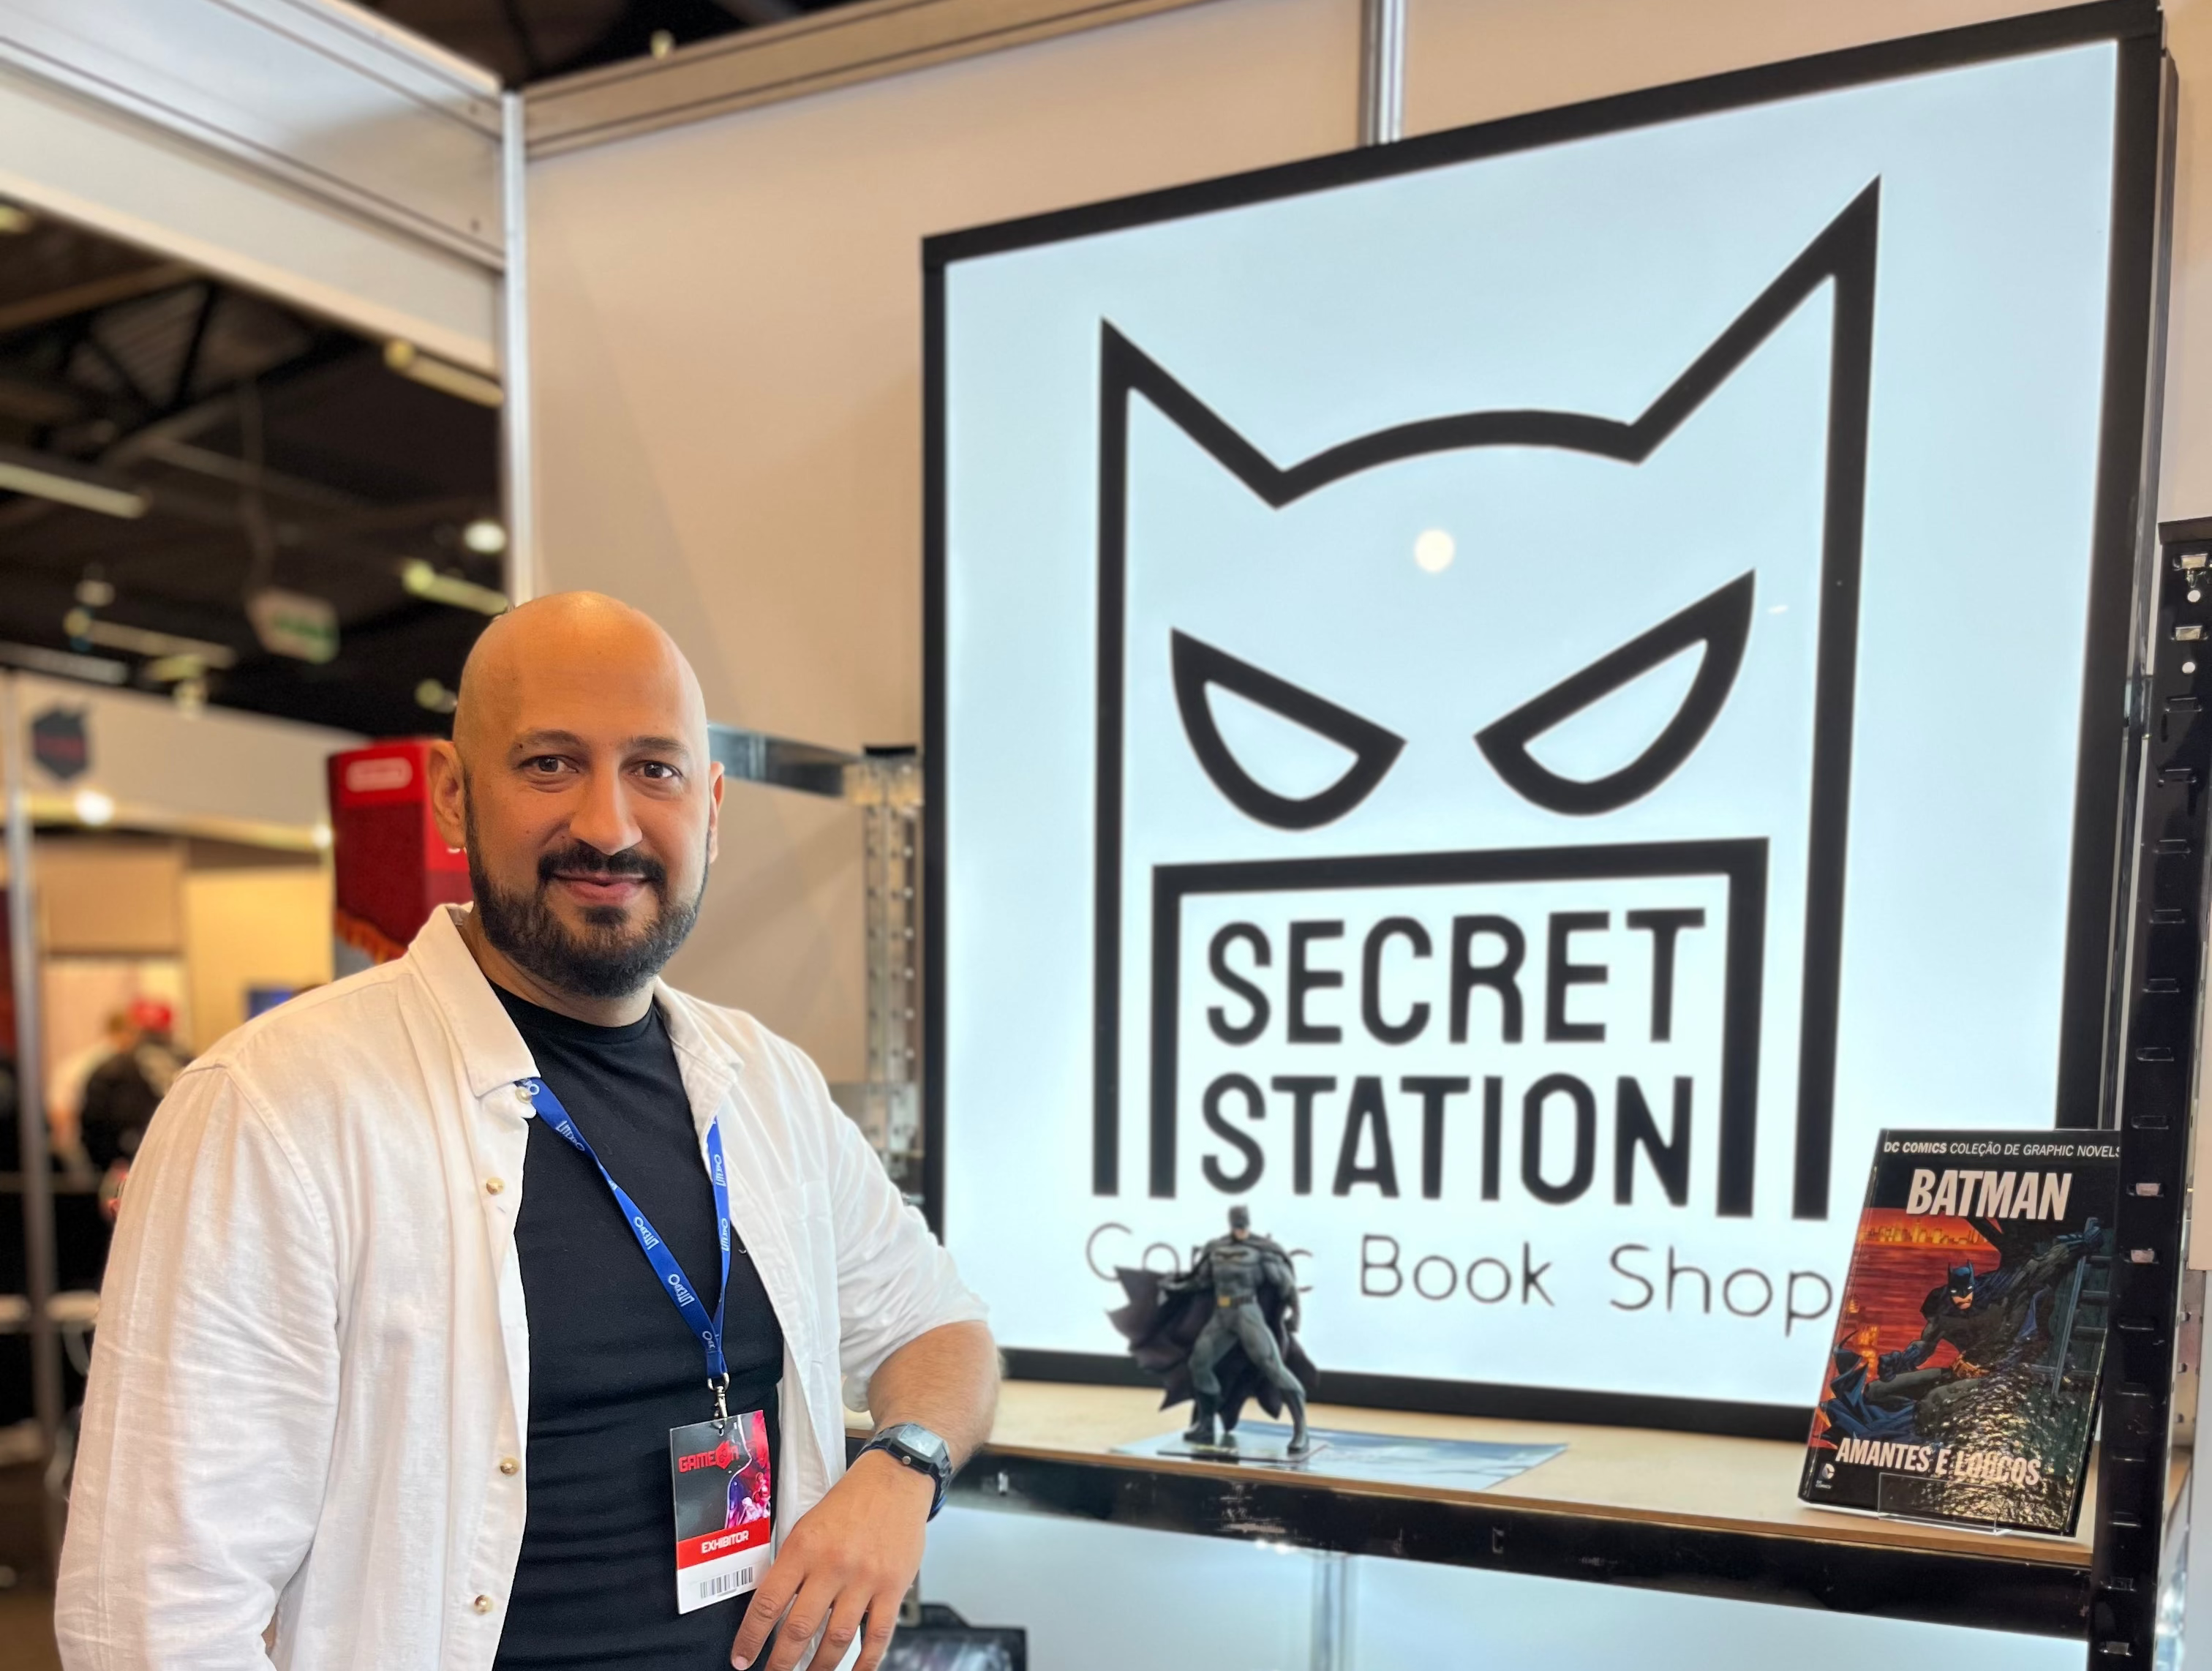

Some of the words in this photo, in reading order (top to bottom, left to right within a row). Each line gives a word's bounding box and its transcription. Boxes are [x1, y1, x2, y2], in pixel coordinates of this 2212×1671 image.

[1208, 908, 1705, 1045] SECRET
[1202, 1073, 1693, 1206] STATION
[1884, 1142, 1899, 1153] DC
[1902, 1142, 1947, 1154] COMICS
[1949, 1141, 2001, 1157] COLEÇÃO
[2004, 1144, 2021, 1155] DE
[2023, 1144, 2074, 1156] GRAPHIC
[1906, 1168, 2073, 1220] BATMAN
[1360, 1233, 1554, 1307] Book
[1609, 1243, 1833, 1337] Shop
[1835, 1438, 1932, 1473] AMANTES
[1934, 1448, 1952, 1475] E
[701, 1530, 749, 1554] EXHIBITOR
